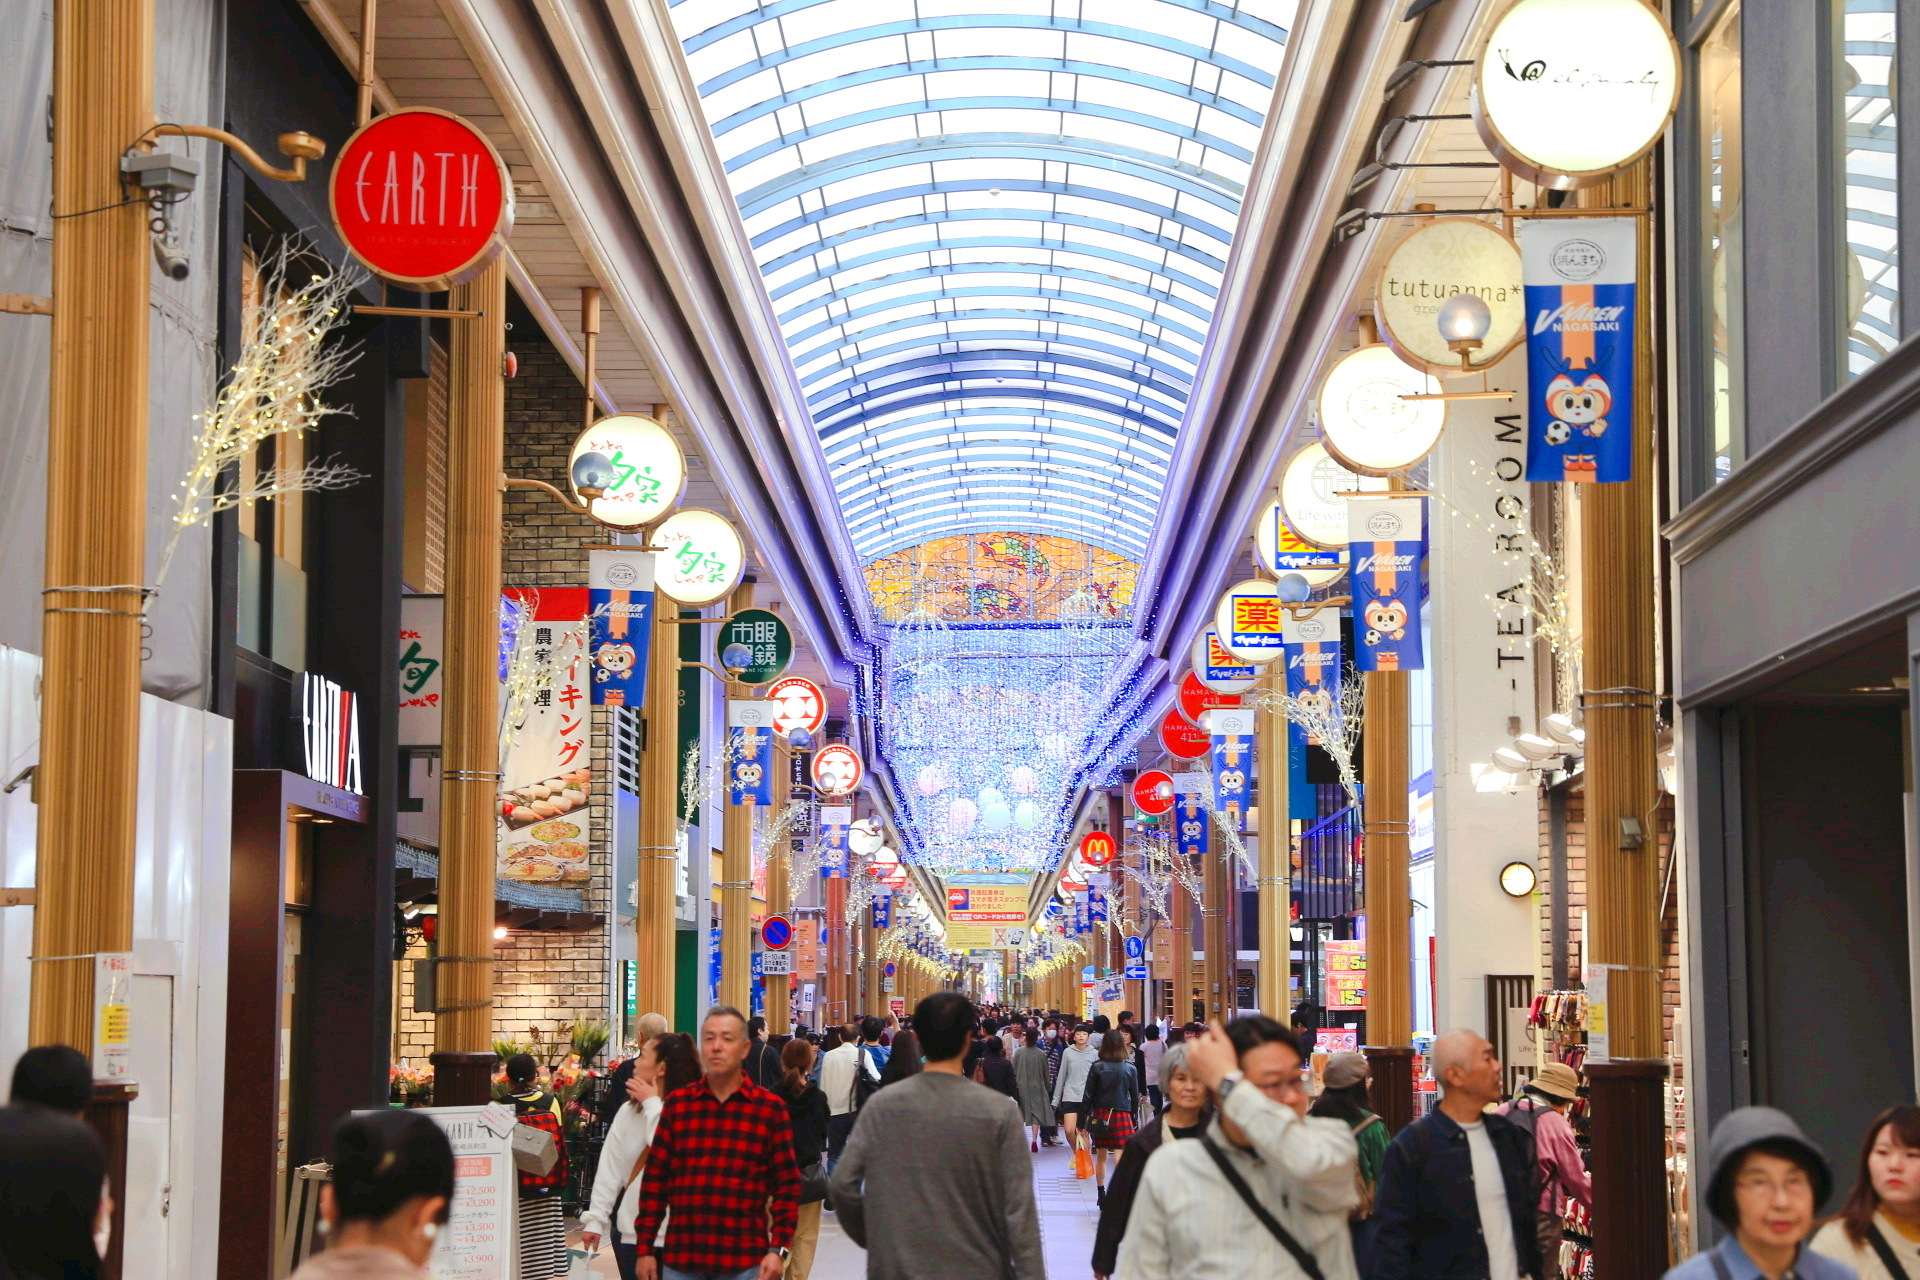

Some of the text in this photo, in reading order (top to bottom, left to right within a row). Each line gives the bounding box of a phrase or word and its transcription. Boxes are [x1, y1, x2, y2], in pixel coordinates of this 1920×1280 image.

[355, 151, 479, 227] EARTH
[1552, 321, 1620, 332] NAGASAKI
[1494, 414, 1524, 669] TEA ROOM
[604, 611, 643, 619] NAGASAKI
[1236, 600, 1279, 632] 薬
[557, 631, 585, 767] バイキング
